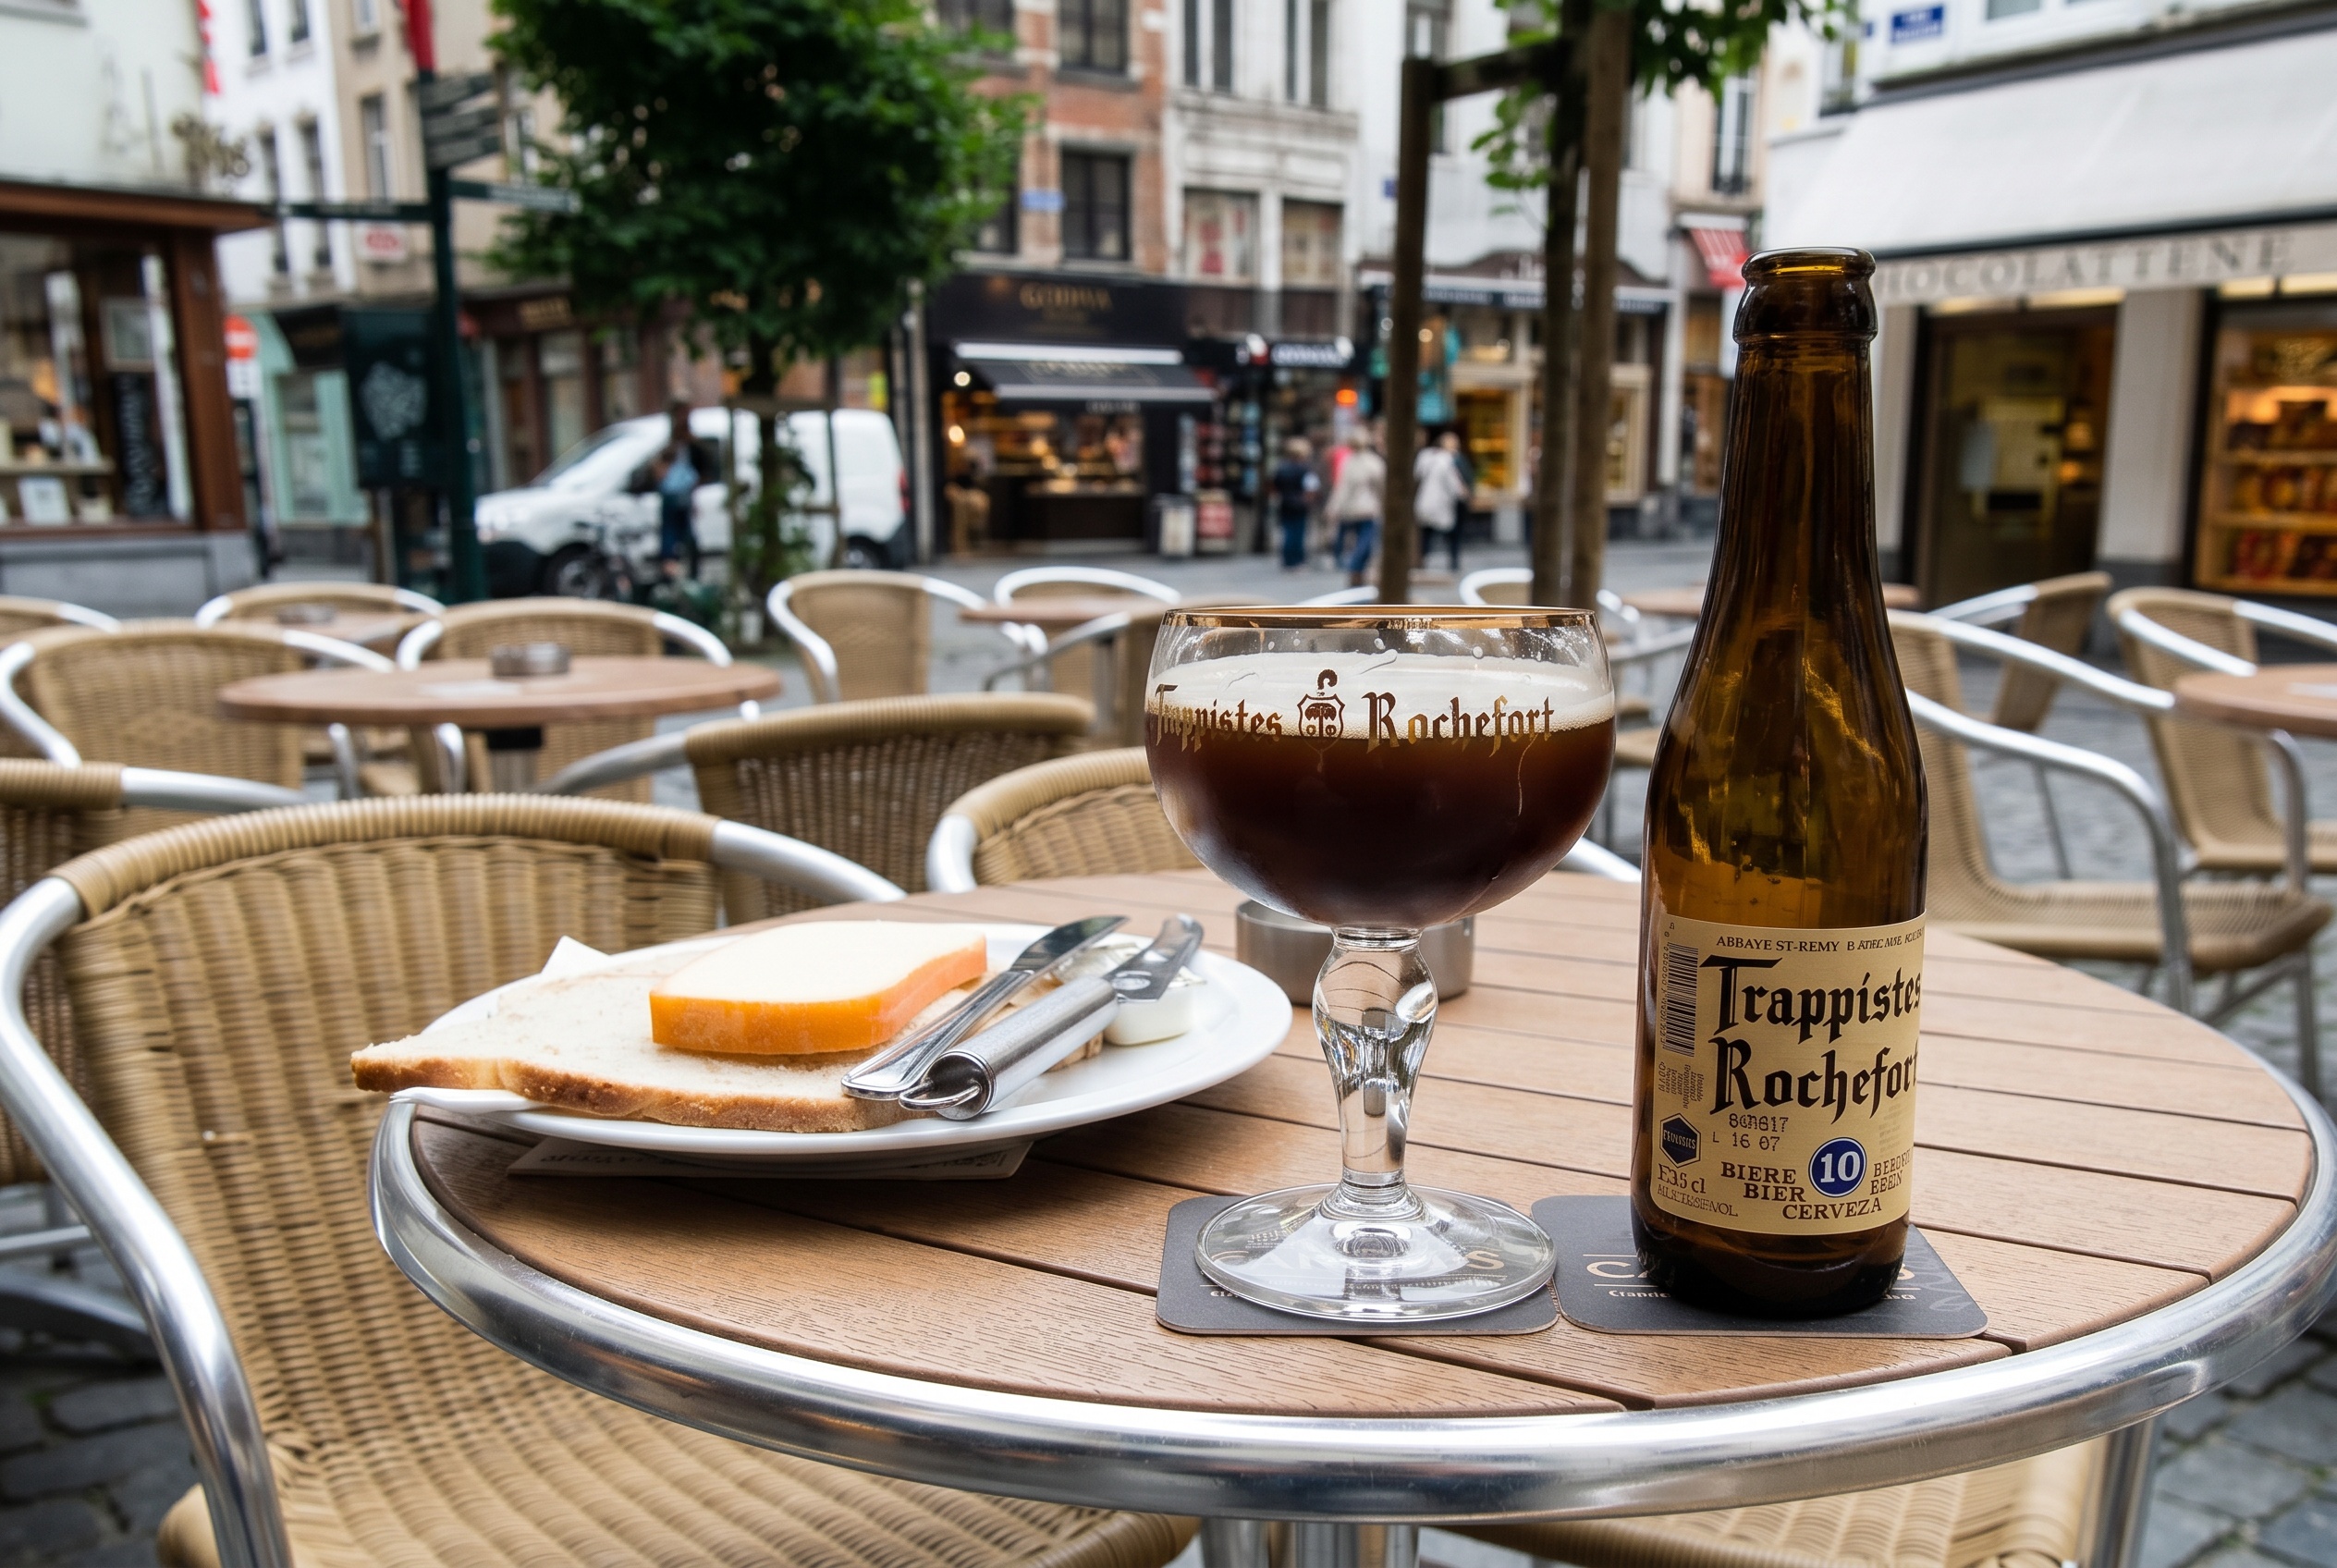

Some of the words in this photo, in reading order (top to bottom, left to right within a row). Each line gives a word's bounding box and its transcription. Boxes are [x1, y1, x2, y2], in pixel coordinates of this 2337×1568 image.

[1716, 936, 1772, 950] ABBAYE
[1776, 939, 1840, 952] ST-REMY
[1699, 954, 1921, 1044] Trappistes
[1708, 1036, 1919, 1124] Rochefort
[1720, 1161, 1796, 1184] BIERE
[1820, 1151, 1861, 1182] 10
[1743, 1182, 1806, 1202] BIER
[1782, 1197, 1882, 1219] CERVEZA
